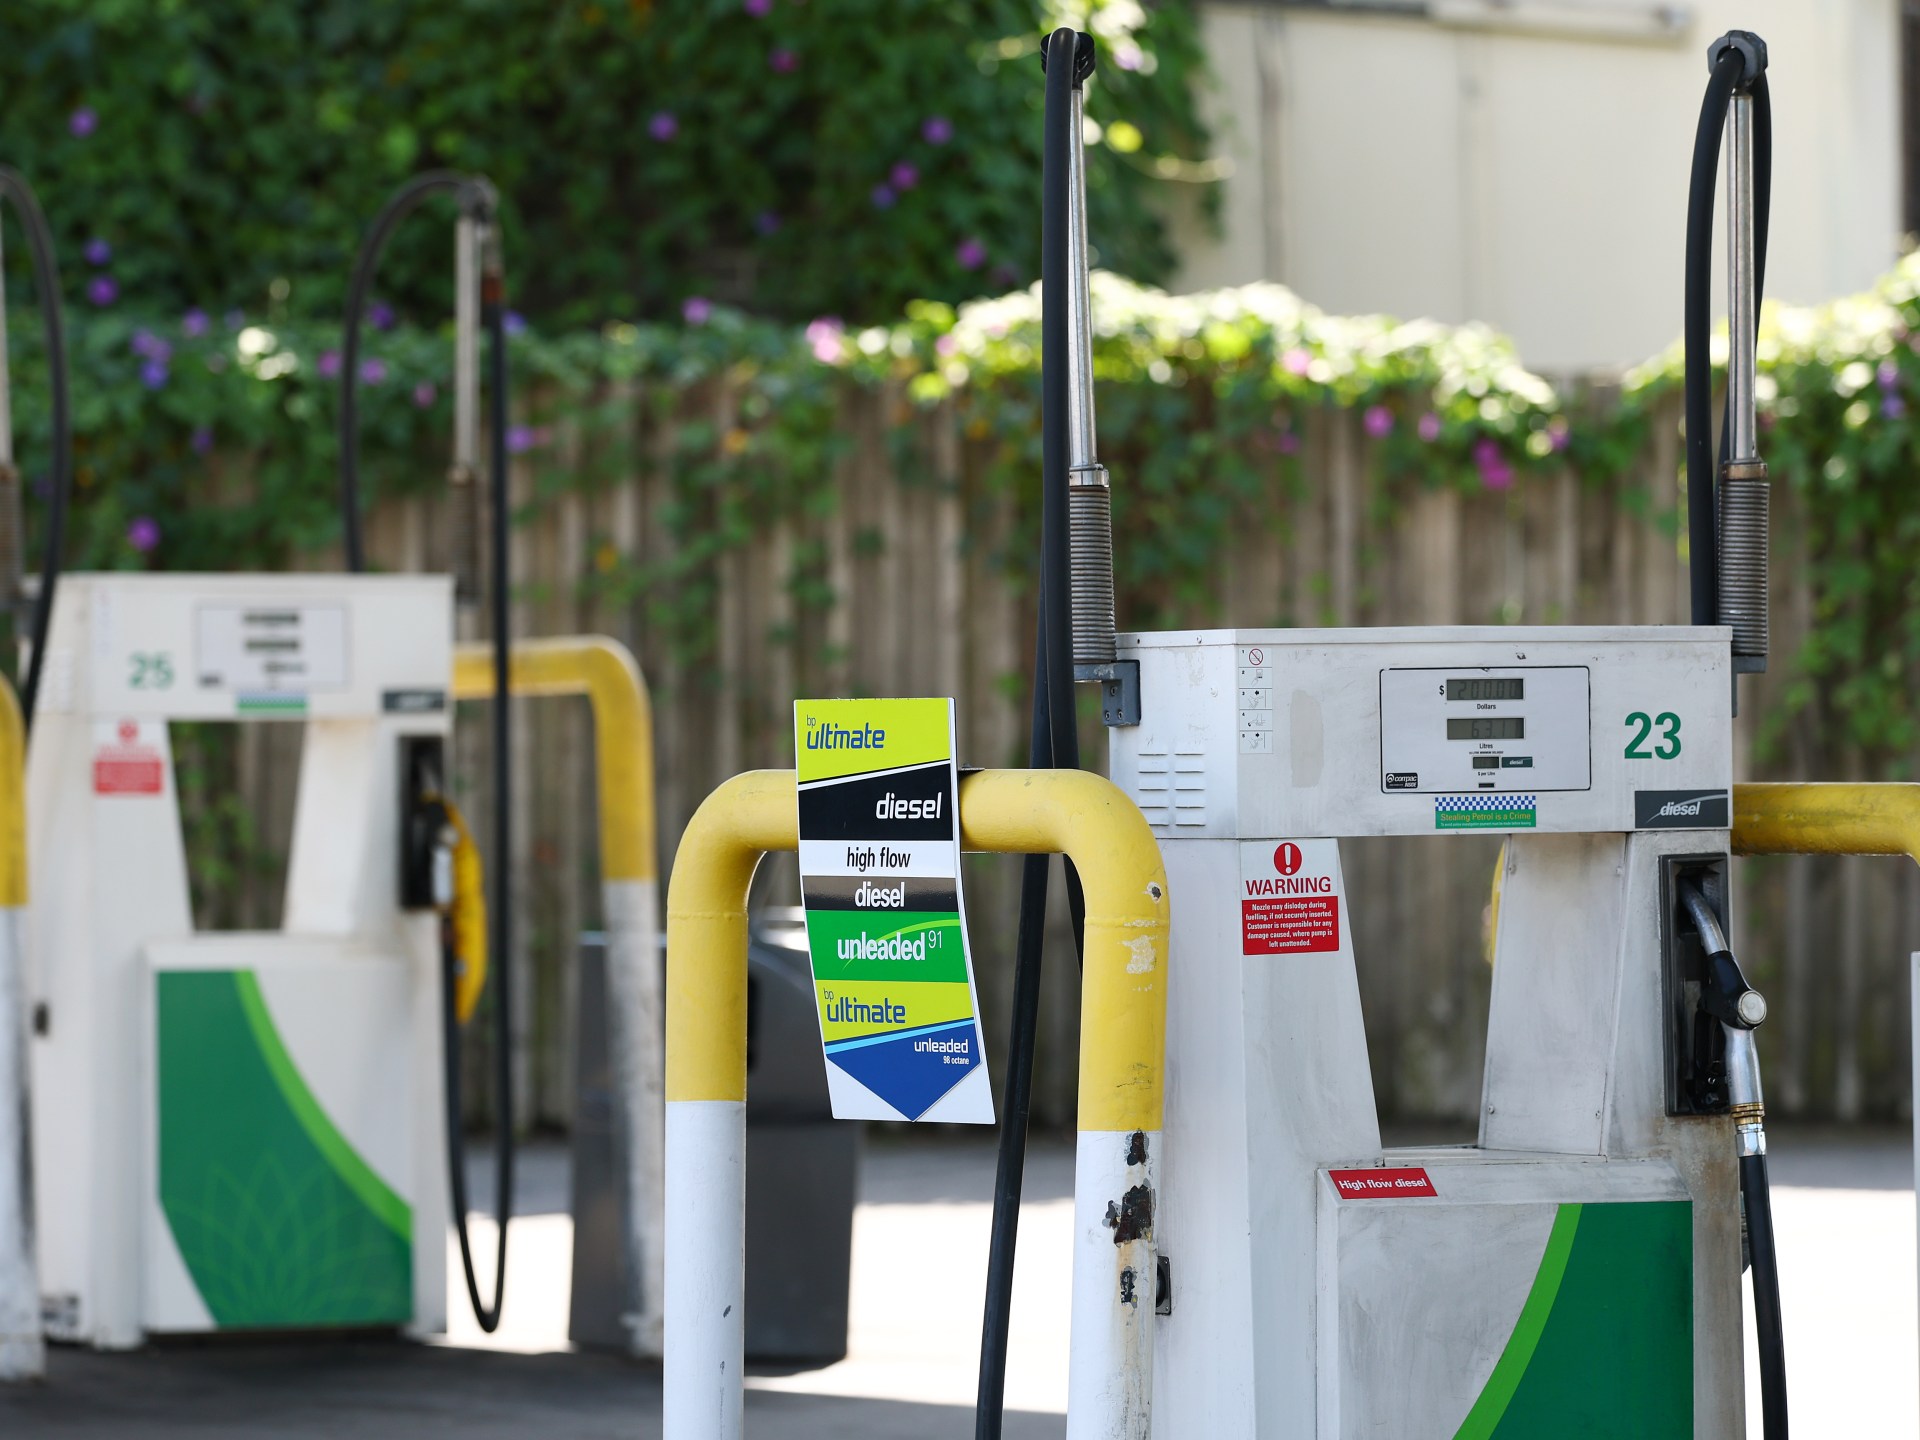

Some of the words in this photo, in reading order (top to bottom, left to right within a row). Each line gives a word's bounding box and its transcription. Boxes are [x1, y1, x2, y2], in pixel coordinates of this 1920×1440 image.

[1439, 685, 1445, 695] $
[806, 715, 816, 728] bp
[806, 722, 885, 749] ultimate
[1624, 712, 1682, 760] 23
[875, 792, 942, 819] diesel
[1660, 801, 1701, 816] diesel
[1441, 813, 1470, 822] Stealing
[1472, 812, 1494, 820] Petrol
[1495, 812, 1502, 820] is
[1510, 811, 1531, 820] Crime
[847, 847, 875, 872] high
[880, 847, 911, 868] flow
[1246, 876, 1331, 895] WARNING
[855, 881, 905, 907] diesel
[1284, 902, 1308, 910] dislodge
[1308, 901, 1327, 909] during
[1245, 913, 1269, 921] fuelling,
[1284, 911, 1308, 919] securely
[1309, 910, 1333, 918] inserted.
[1247, 922, 1273, 930] Customer
[1280, 920, 1312, 929] responsible
[1322, 920, 1333, 928] any
[1247, 932, 1269, 940] damage
[1270, 930, 1292, 938] caused,
[1311, 930, 1326, 938] pump
[837, 931, 926, 961] unleaded
[928, 930, 943, 949] 91
[1269, 940, 1278, 948] left
[1279, 939, 1312, 947] unattended.
[823, 988, 834, 1001] bp
[826, 997, 906, 1023] ultimate
[914, 1037, 969, 1053] unleaded
[943, 1055, 951, 1065] 98
[951, 1056, 970, 1065] octane
[1338, 1179, 1366, 1191] High
[1367, 1179, 1393, 1188] flow
[1394, 1178, 1428, 1188] diesel
